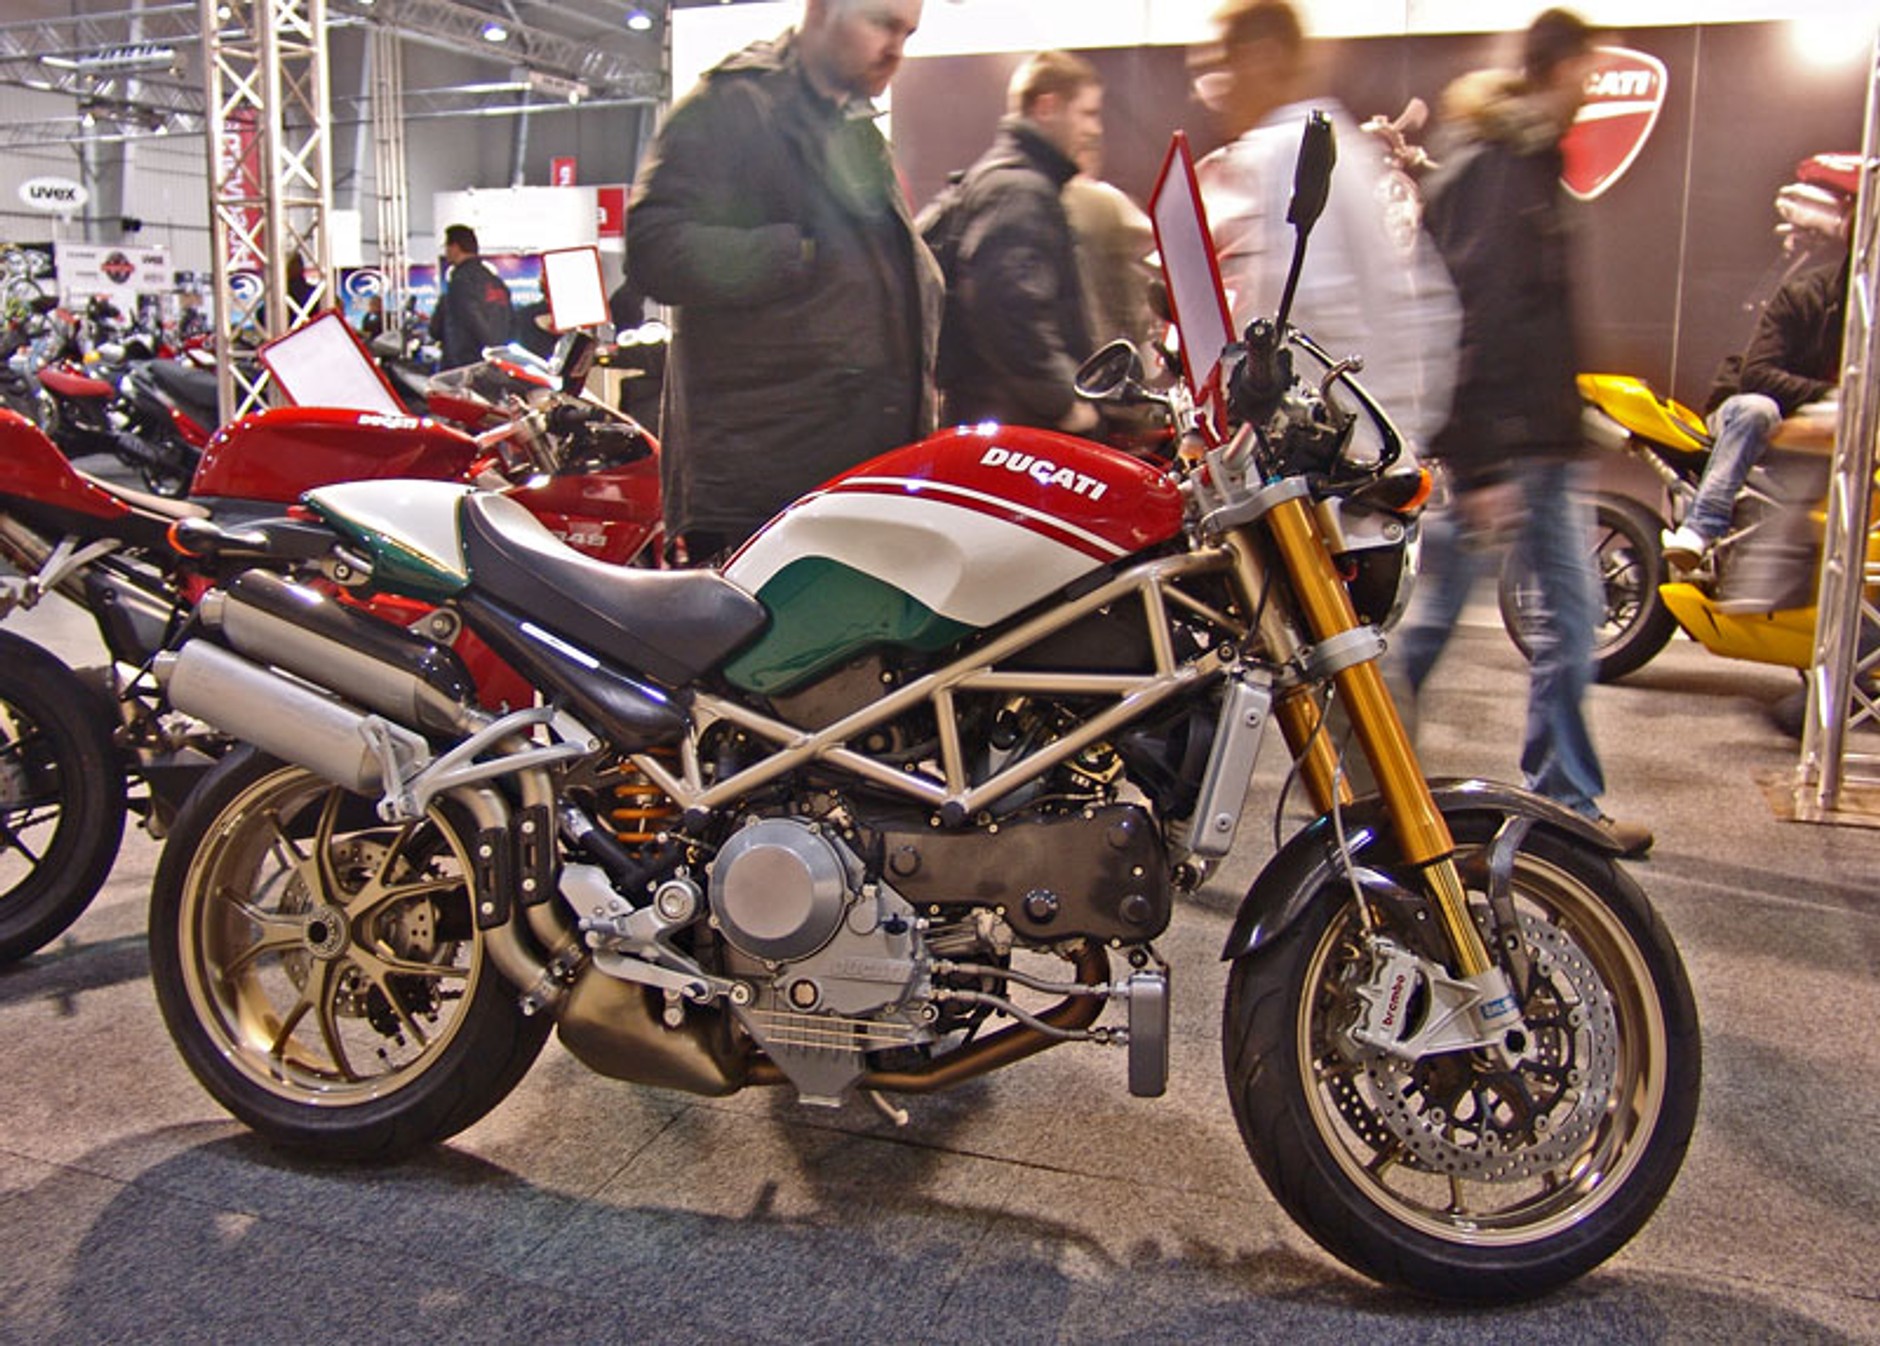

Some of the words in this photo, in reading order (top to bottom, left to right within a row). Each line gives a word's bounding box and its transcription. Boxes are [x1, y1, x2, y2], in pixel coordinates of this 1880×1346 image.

[1584, 70, 1652, 96] CATI
[30, 186, 75, 201] uvex
[980, 446, 1108, 501] DUCATI
[1382, 974, 1406, 1026] brembo
